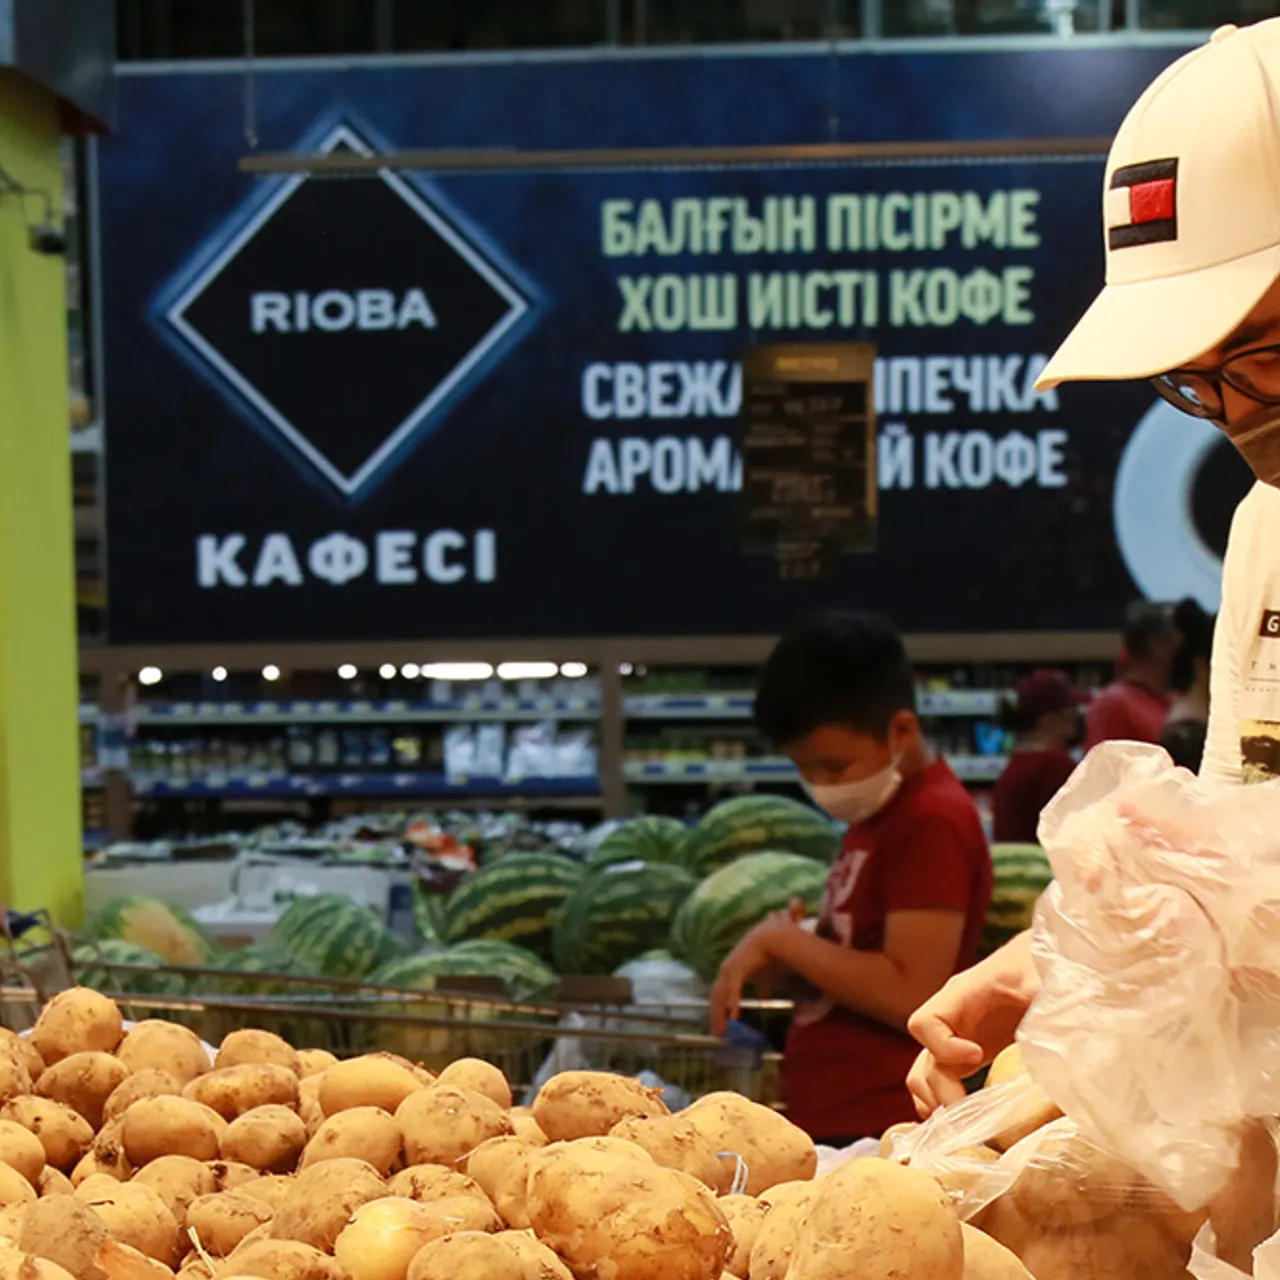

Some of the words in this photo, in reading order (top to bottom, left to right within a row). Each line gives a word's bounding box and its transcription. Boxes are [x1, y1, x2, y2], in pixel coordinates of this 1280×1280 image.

[600, 194, 814, 258] БАЛҒЫН
[825, 189, 1040, 253] ПІСІРМЕ
[250, 289, 437, 334] RIOBA
[616, 271, 738, 333] ХОШ
[747, 269, 879, 330] ИІСТІ
[889, 265, 1036, 327] КОФЕ
[924, 428, 1070, 489] КОФЕ
[196, 529, 498, 589] КАФЕСІ
